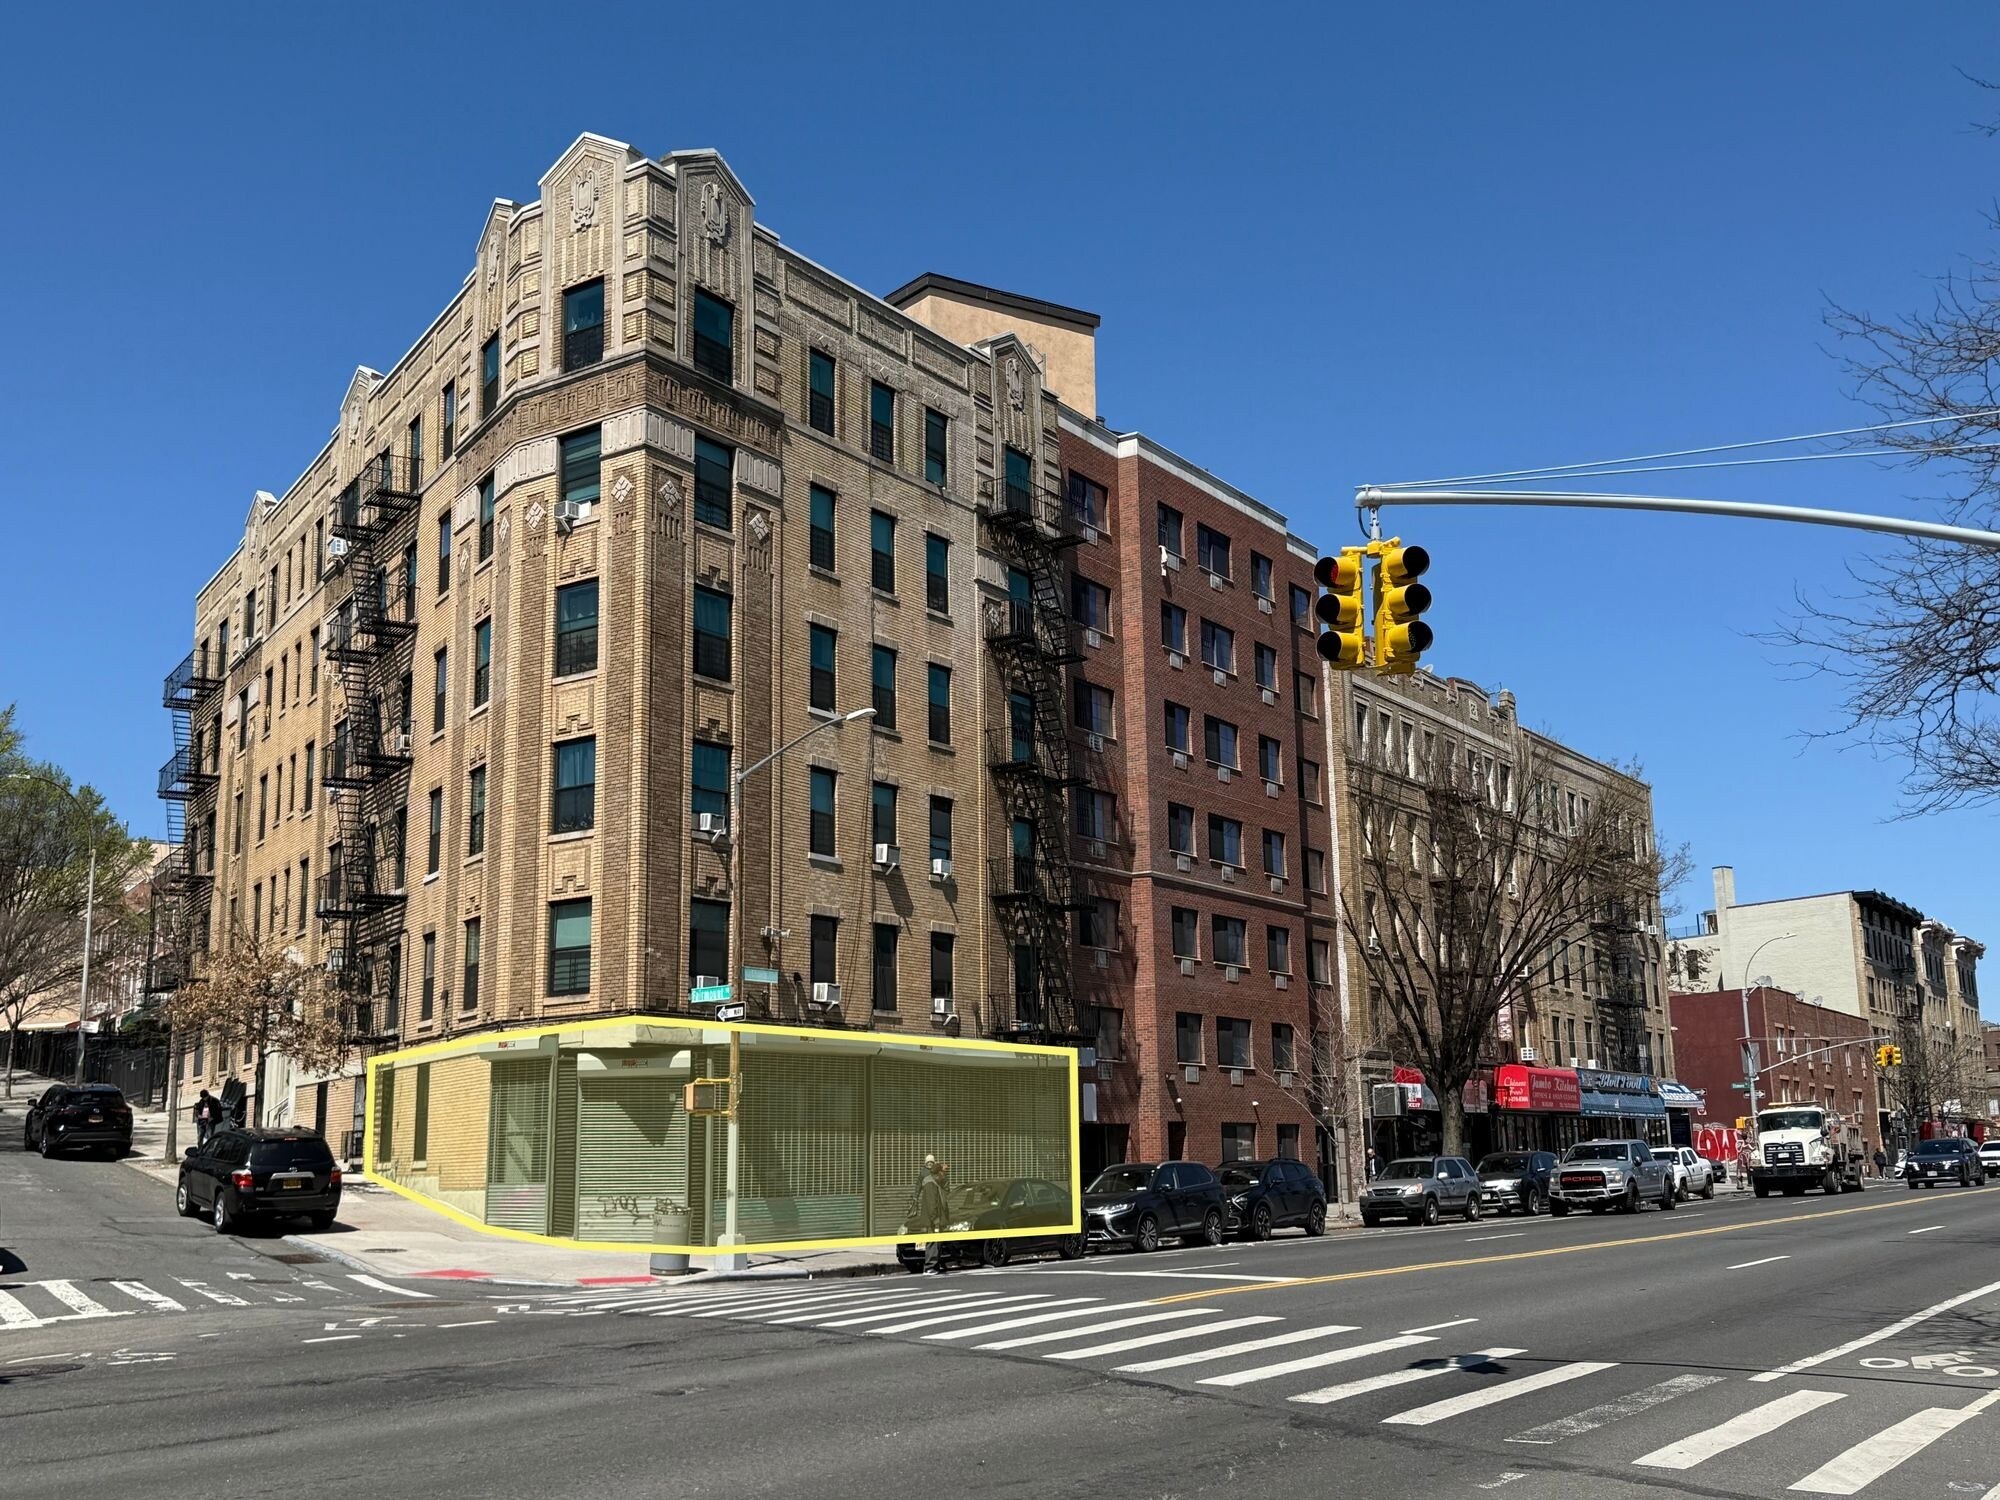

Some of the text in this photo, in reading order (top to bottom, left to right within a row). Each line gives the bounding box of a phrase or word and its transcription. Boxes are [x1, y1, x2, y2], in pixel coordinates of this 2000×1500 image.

[720, 1008, 742, 1018] ONE WAY
[1504, 1077, 1527, 1087] Chinese
[1531, 1075, 1577, 1092] Jumbo Kitchen
[1509, 1087, 1523, 1096] Food
